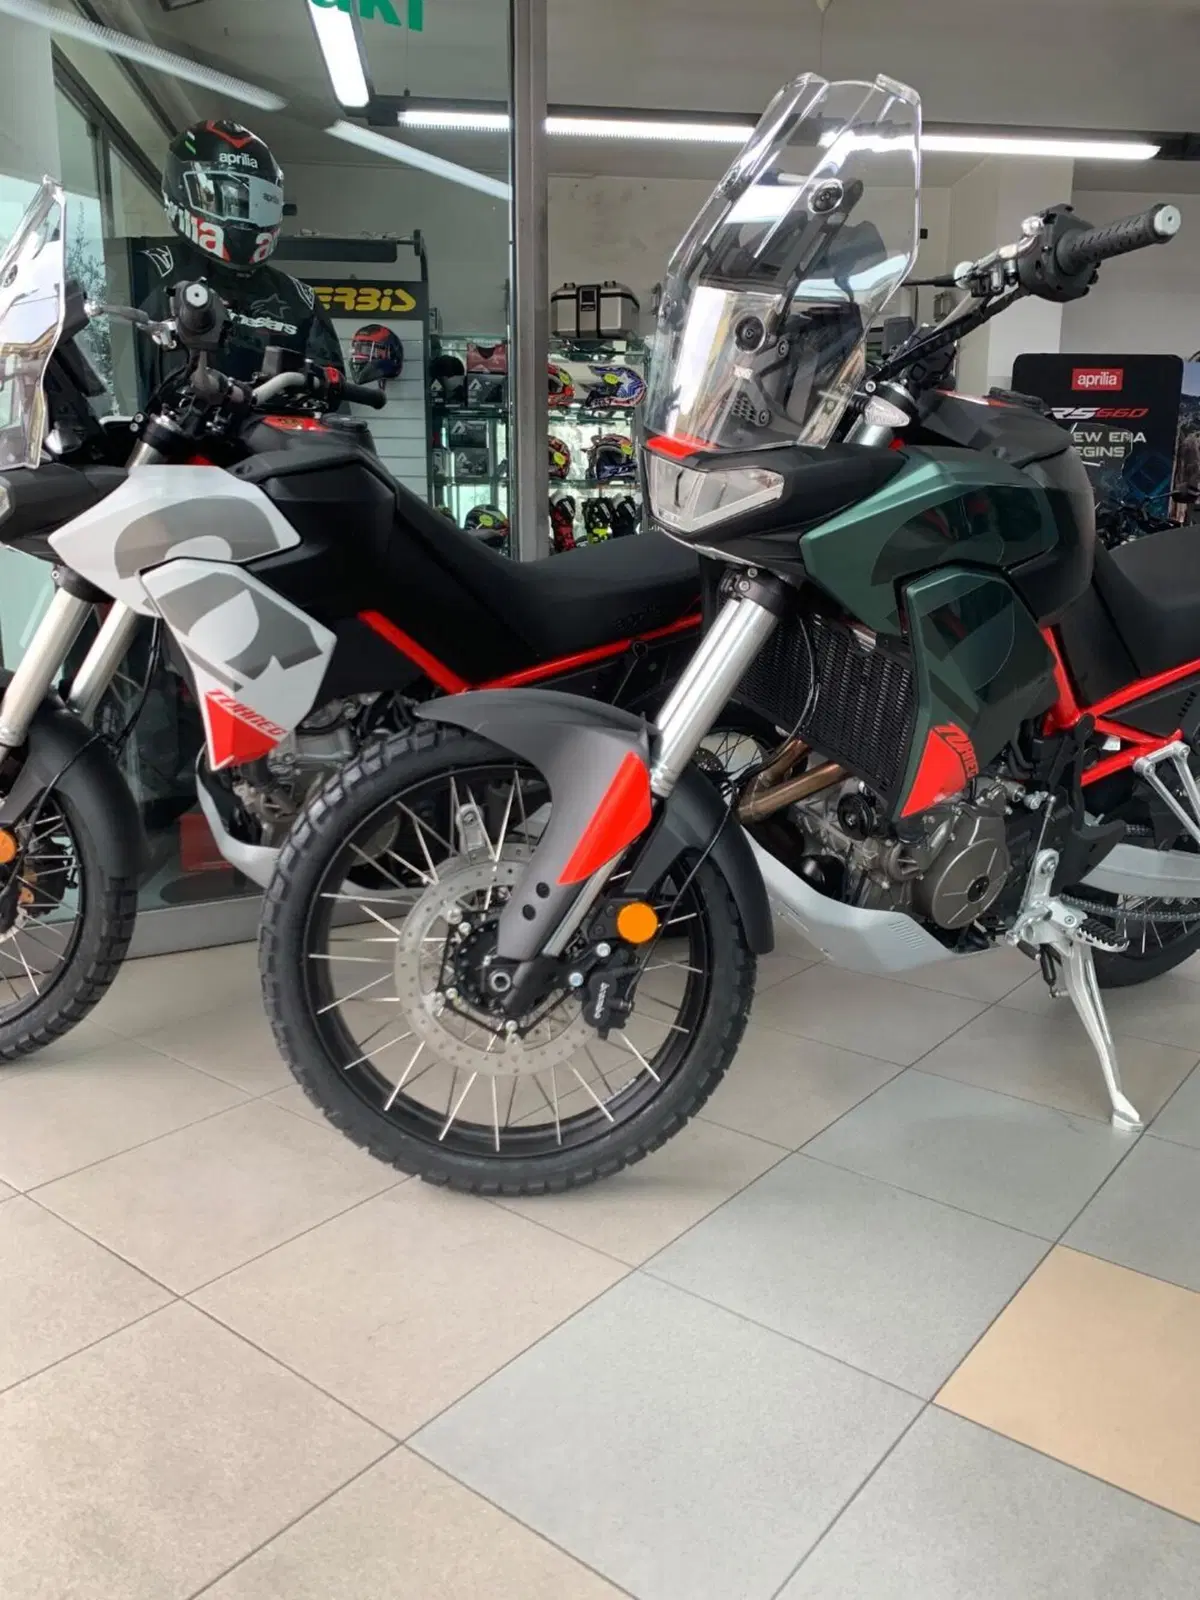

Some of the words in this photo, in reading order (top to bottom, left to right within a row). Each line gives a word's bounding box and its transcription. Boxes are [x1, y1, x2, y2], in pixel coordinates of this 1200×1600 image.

[219, 152, 258, 169] aprilia
[1077, 371, 1118, 388] aprilia
[1073, 432, 1103, 443] EW
[1109, 432, 1147, 443] ERA
[1075, 446, 1126, 457] EGINS
